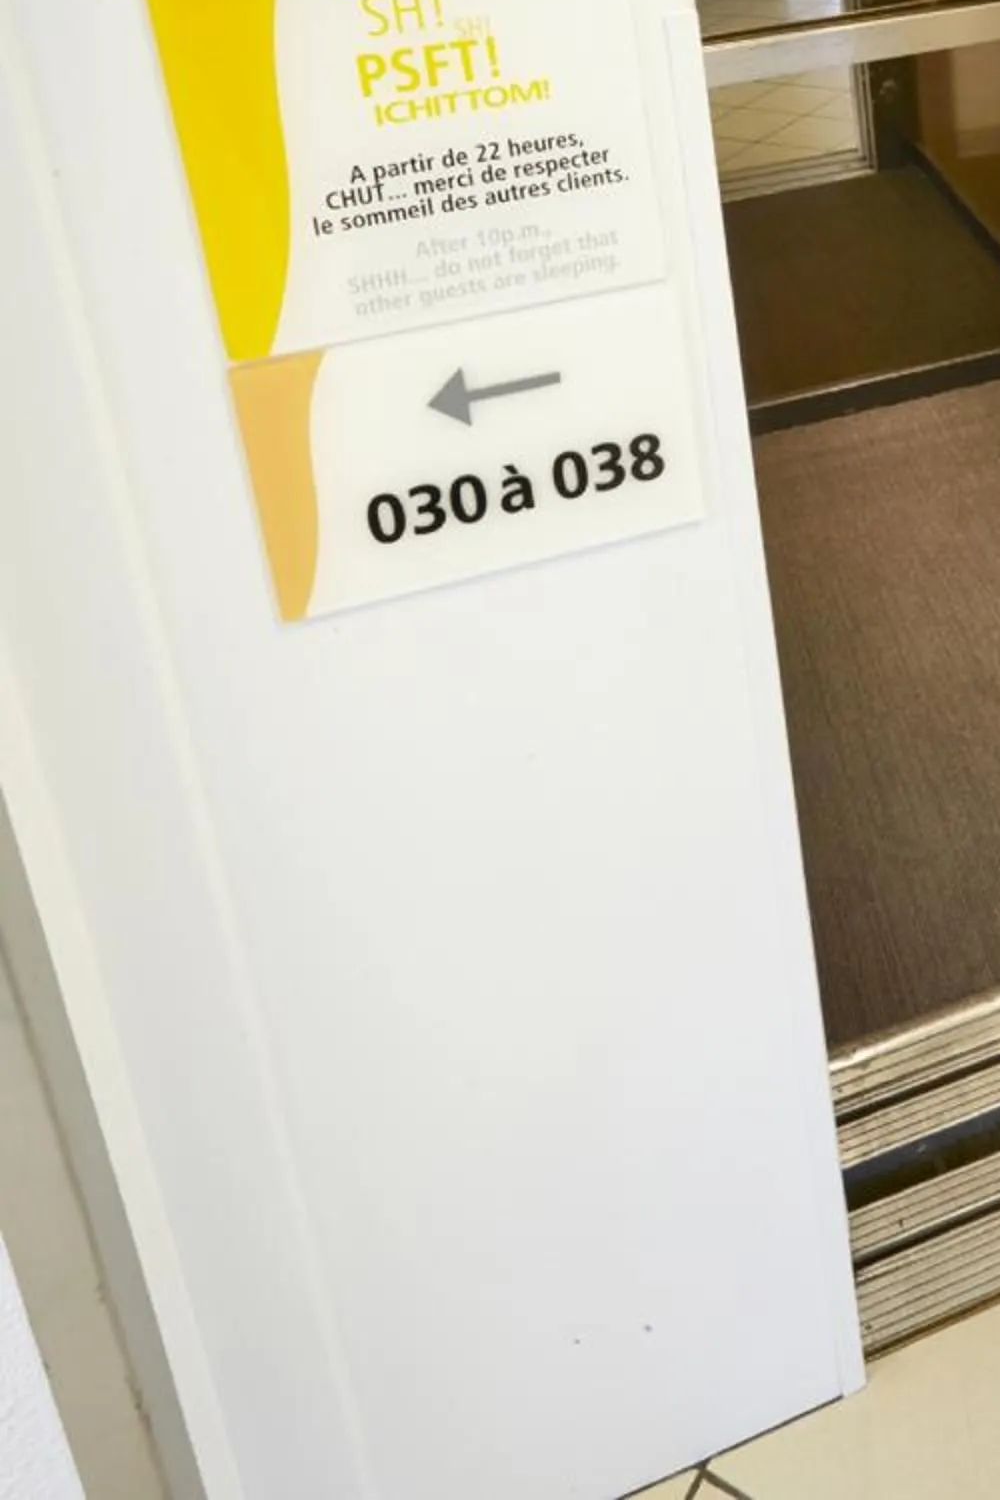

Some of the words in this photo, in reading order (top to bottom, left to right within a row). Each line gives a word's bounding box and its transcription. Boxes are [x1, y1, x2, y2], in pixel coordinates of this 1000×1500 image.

[355, 36, 500, 99] PSFT!
[374, 78, 553, 127] ICHITTOM!
[325, 182, 408, 211] CHUT...
[413, 167, 475, 196] merci
[480, 164, 508, 185] de
[513, 148, 610, 178] respecter
[350, 164, 367, 184] A
[372, 152, 435, 184] partir
[441, 147, 469, 168] de
[474, 141, 500, 164] 22
[507, 133, 585, 158] heures,
[312, 216, 334, 237] le
[340, 197, 435, 231] sommeil
[441, 194, 479, 214] des
[485, 180, 552, 206] autres
[556, 168, 630, 193] clients.
[415, 237, 469, 259] After
[434, 259, 462, 281] do
[468, 251, 501, 273] not
[507, 238, 572, 265] forget
[576, 227, 620, 248] that
[355, 292, 412, 318] other
[418, 278, 489, 308] guests
[493, 271, 528, 292] are
[532, 252, 622, 284] sleeping.
[367, 473, 489, 544] 030
[500, 463, 536, 514] à
[552, 432, 666, 499] 038
